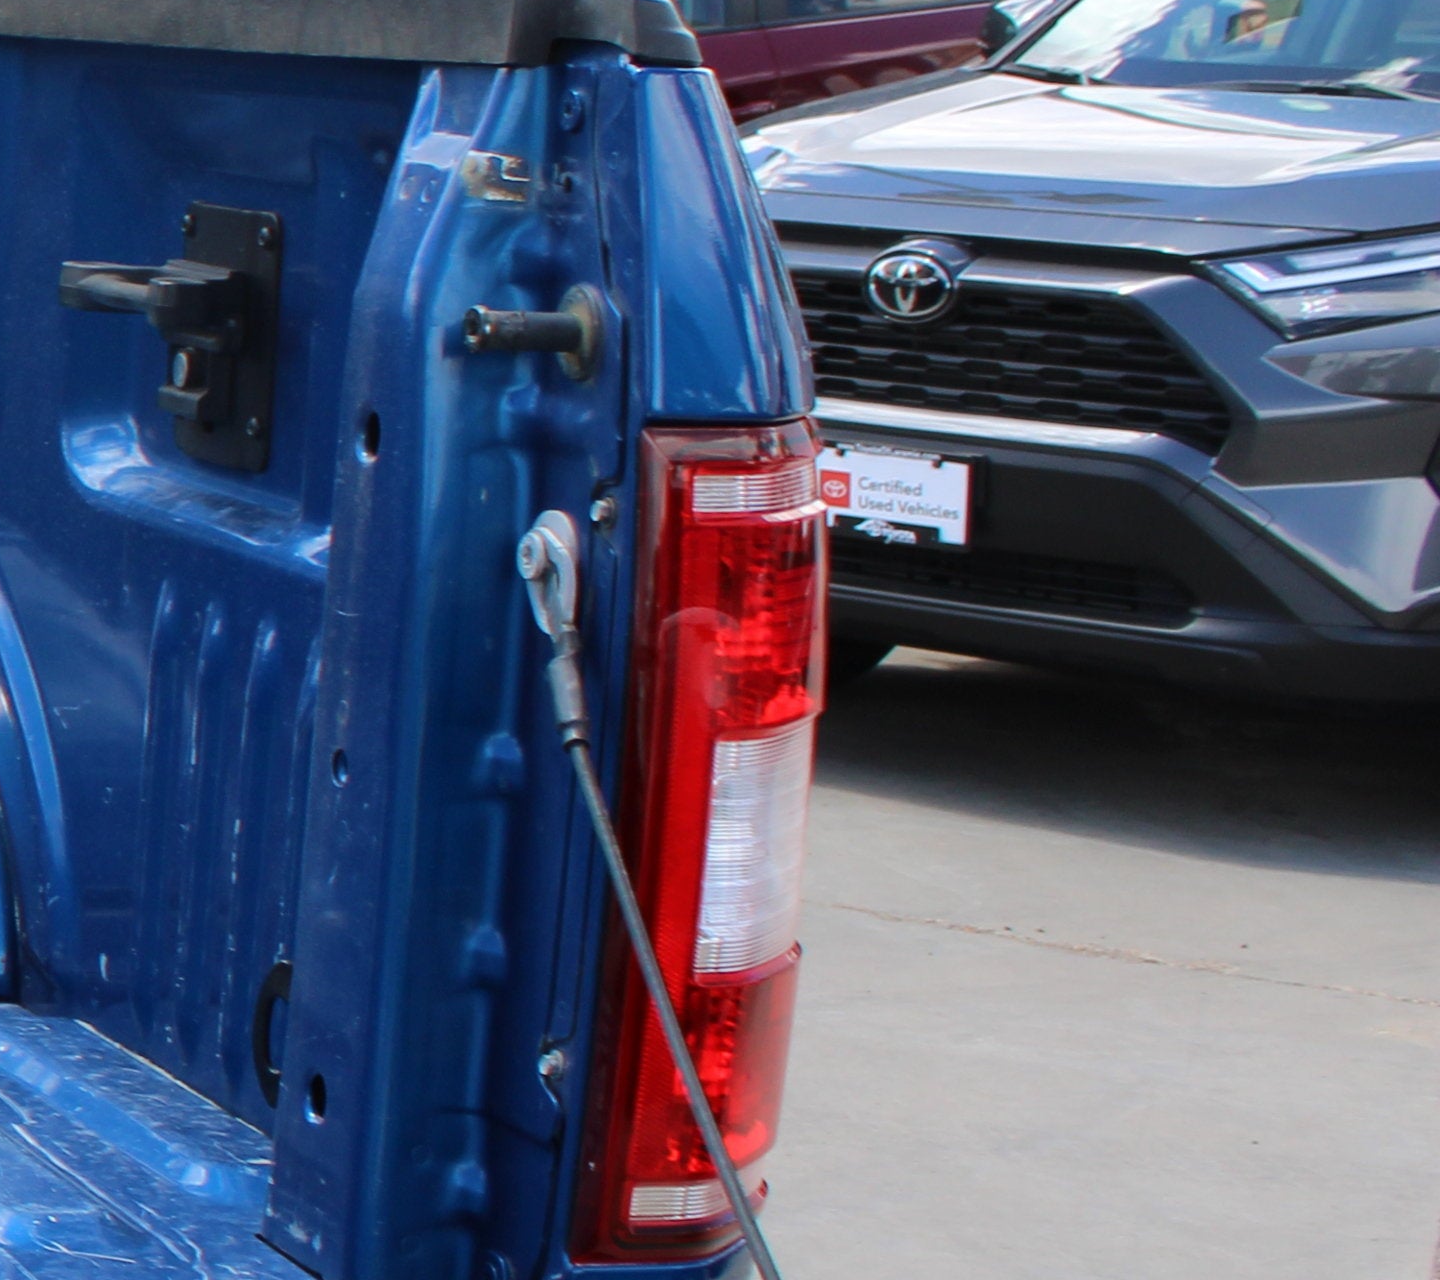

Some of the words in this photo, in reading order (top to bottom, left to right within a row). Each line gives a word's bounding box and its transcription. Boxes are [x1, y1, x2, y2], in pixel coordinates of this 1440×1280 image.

[858, 477, 922, 496] Certified
[858, 495, 892, 512] Used
[897, 501, 959, 520] Vehicles
